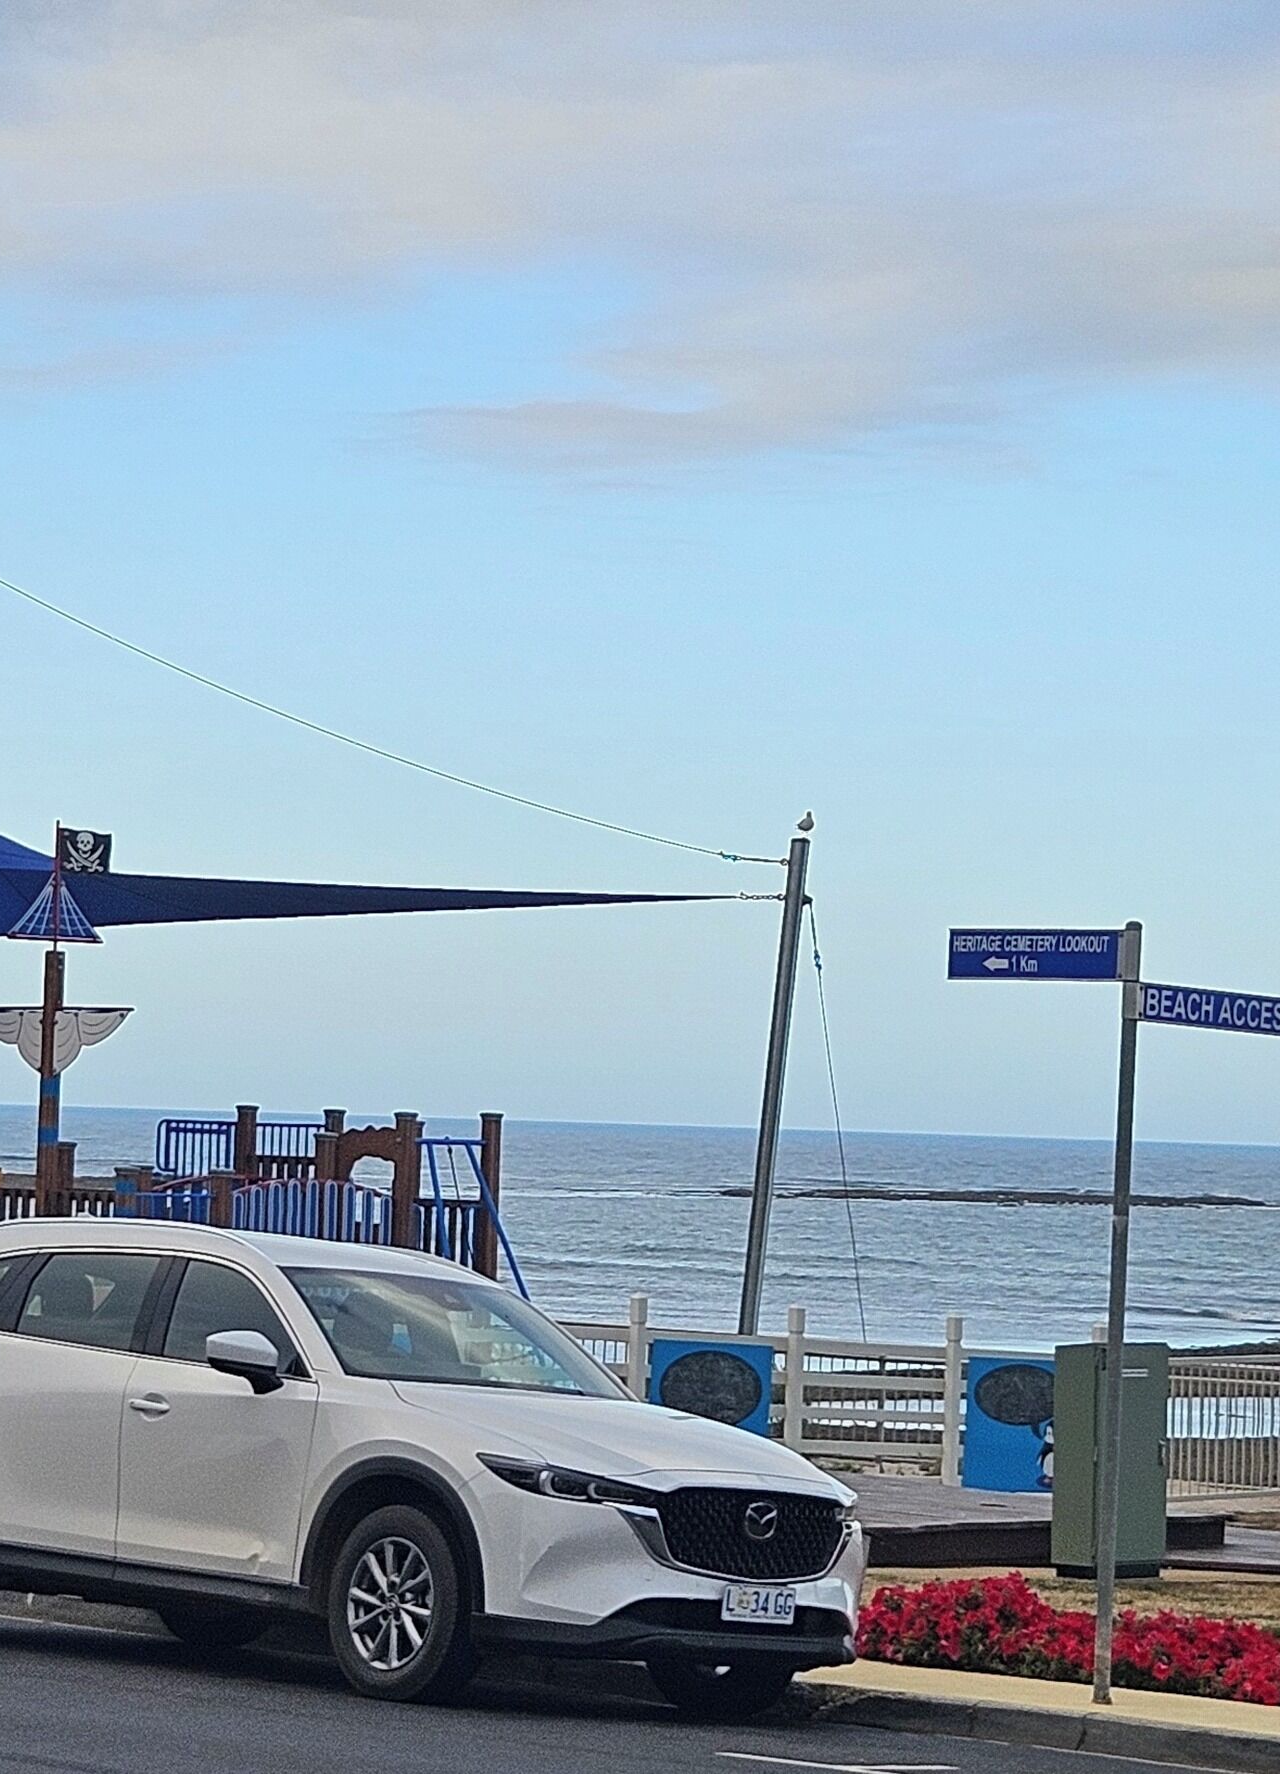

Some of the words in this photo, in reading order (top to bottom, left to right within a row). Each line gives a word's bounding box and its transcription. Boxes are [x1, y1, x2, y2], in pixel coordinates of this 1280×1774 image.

[953, 935, 1002, 952] HERITAGE
[1004, 935, 1058, 952] CEMETERY
[1059, 936, 1110, 953] LOOKOUT
[1011, 955, 1017, 972] 1
[1020, 955, 1038, 972] Km
[1145, 988, 1214, 1022] BEACH
